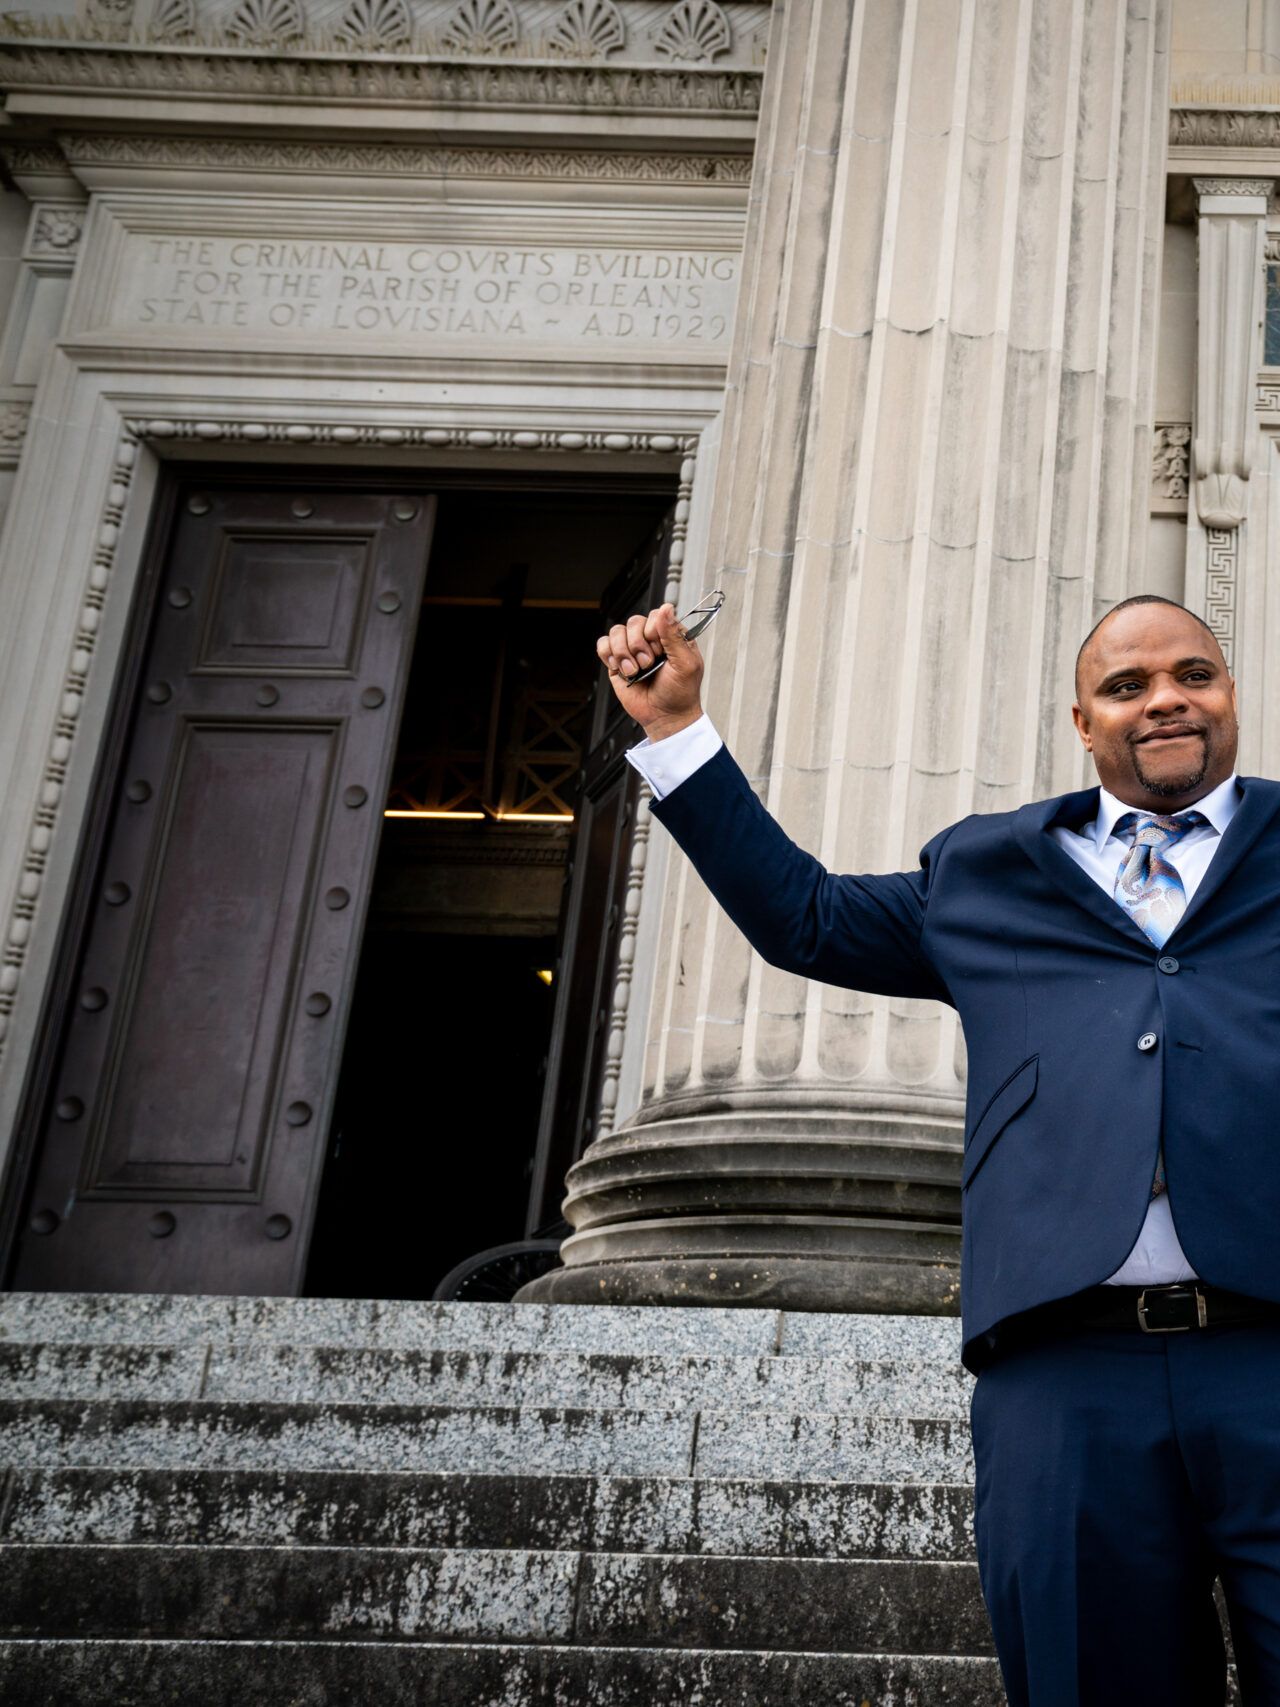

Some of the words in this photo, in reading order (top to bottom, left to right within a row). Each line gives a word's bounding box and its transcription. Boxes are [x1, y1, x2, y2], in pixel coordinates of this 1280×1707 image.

[150, 240, 215, 266] THE
[229, 243, 393, 272] CRIMINAL
[406, 248, 556, 277] COVRTS
[572, 253, 736, 282] BVILDING
[171, 269, 244, 297] FOR
[258, 272, 324, 299] THE
[339, 275, 461, 304] PARISH
[474, 279, 522, 304] OF
[535, 281, 704, 310] ORLEANS
[138, 298, 250, 327] STATE
[268, 302, 318, 328] OF
[331, 304, 528, 334] LOVISIANA
[651, 313, 728, 341] 1929
